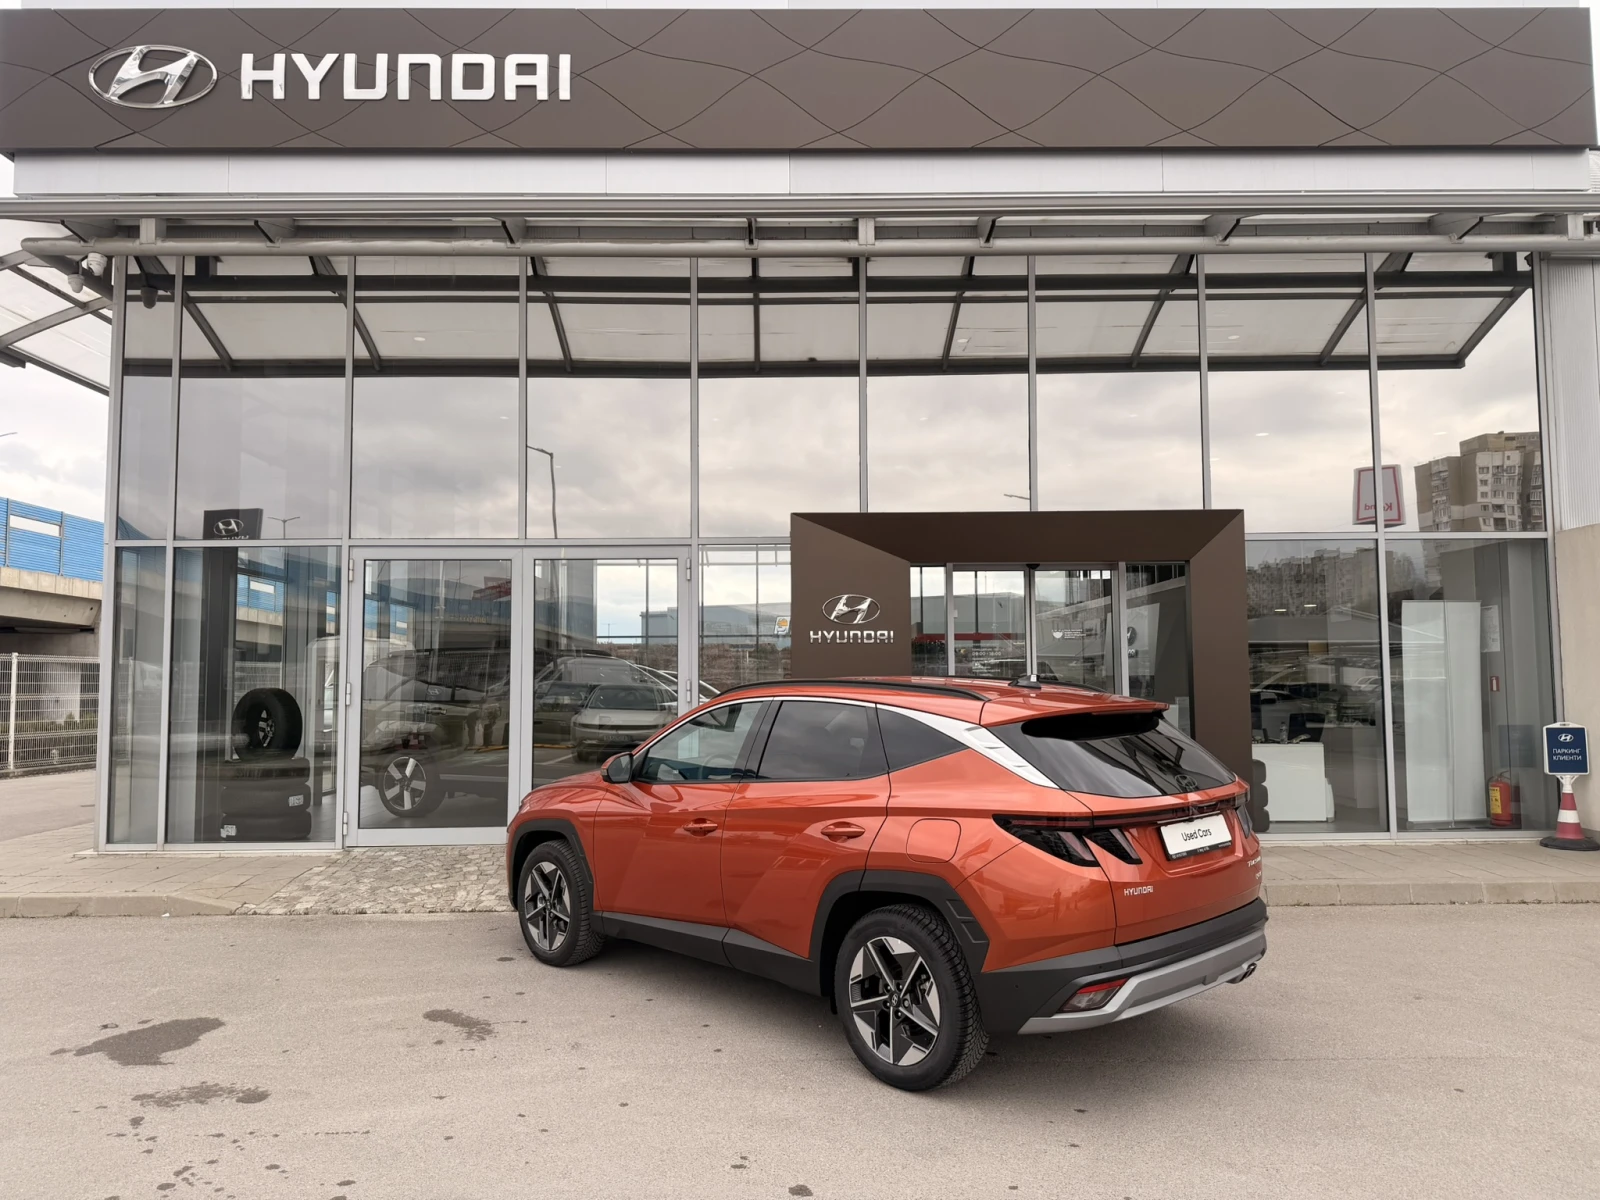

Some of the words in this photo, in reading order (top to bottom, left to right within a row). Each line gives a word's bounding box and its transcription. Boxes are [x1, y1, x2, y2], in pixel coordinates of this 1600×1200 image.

[240, 53, 571, 100] HYUNDAI
[809, 630, 894, 643] HYUNDAI
[1181, 829, 1198, 841] Used
[1197, 828, 1212, 838] Cars
[1123, 885, 1154, 897] HYUNDAI
